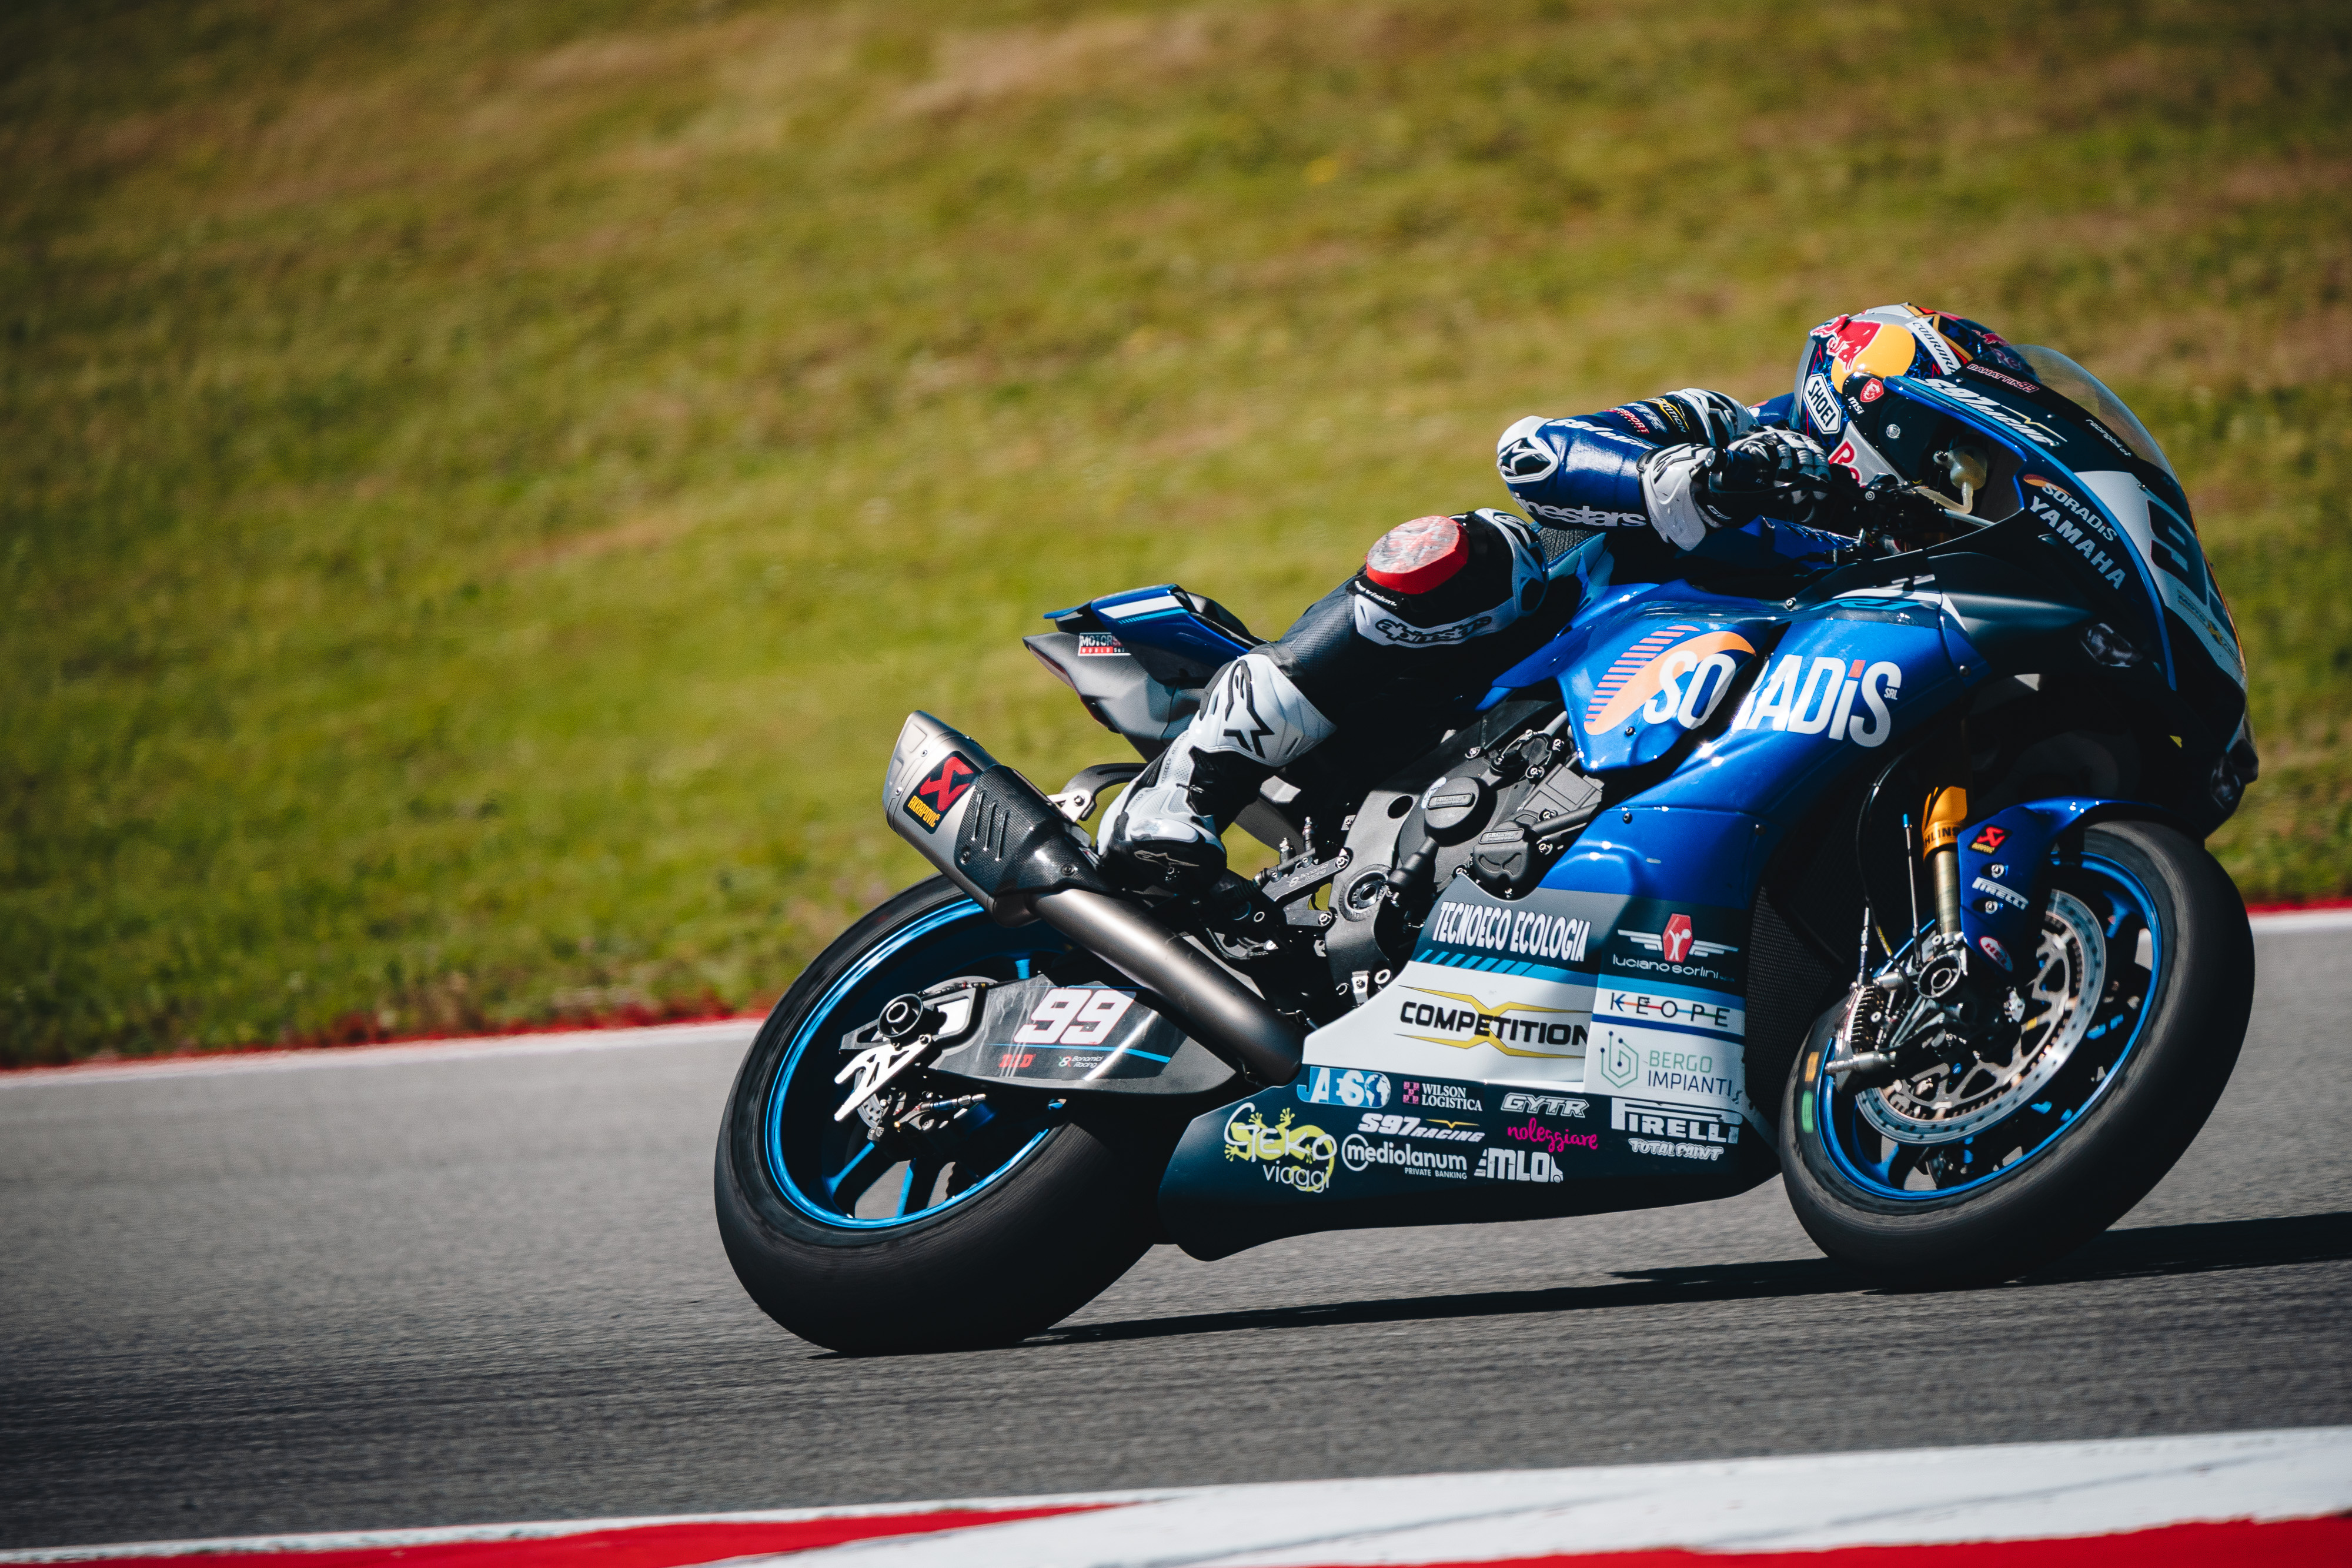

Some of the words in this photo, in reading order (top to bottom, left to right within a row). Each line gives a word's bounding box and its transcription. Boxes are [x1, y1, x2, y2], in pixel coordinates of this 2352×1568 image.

[1808, 380, 1836, 427] SHOEI
[1848, 396, 1865, 414] msi
[2030, 496, 2126, 589] YAMAHA
[1884, 687, 1898, 700] SRL
[1972, 877, 2029, 910] PIRELLI
[1432, 901, 1512, 951] TECNOECO
[1509, 911, 1591, 962] ECOLOGIA
[1613, 954, 1670, 972] luciano
[1672, 965, 1718, 979] sorlini
[1013, 988, 1137, 1045] 99
[1400, 1001, 1588, 1046] COMPETITION
[1610, 992, 1730, 1027] KEOPE
[1646, 1050, 1712, 1074] BERGO
[1422, 1083, 1467, 1099] WILSON
[1648, 1071, 1732, 1097] IMPIANTI
[1421, 1095, 1483, 1112] LOGISTICA
[1501, 1092, 1590, 1118] GYTR
[1224, 1102, 1338, 1163] GEKO
[1507, 1117, 1598, 1152] noleggiare
[1611, 1097, 1743, 1144] PIRELLI
[1347, 1141, 1468, 1171] mediolanum
[1262, 1160, 1330, 1193] viaggi
[1404, 1167, 1432, 1176] PRIVATE
[1435, 1169, 1468, 1180] BANKING
